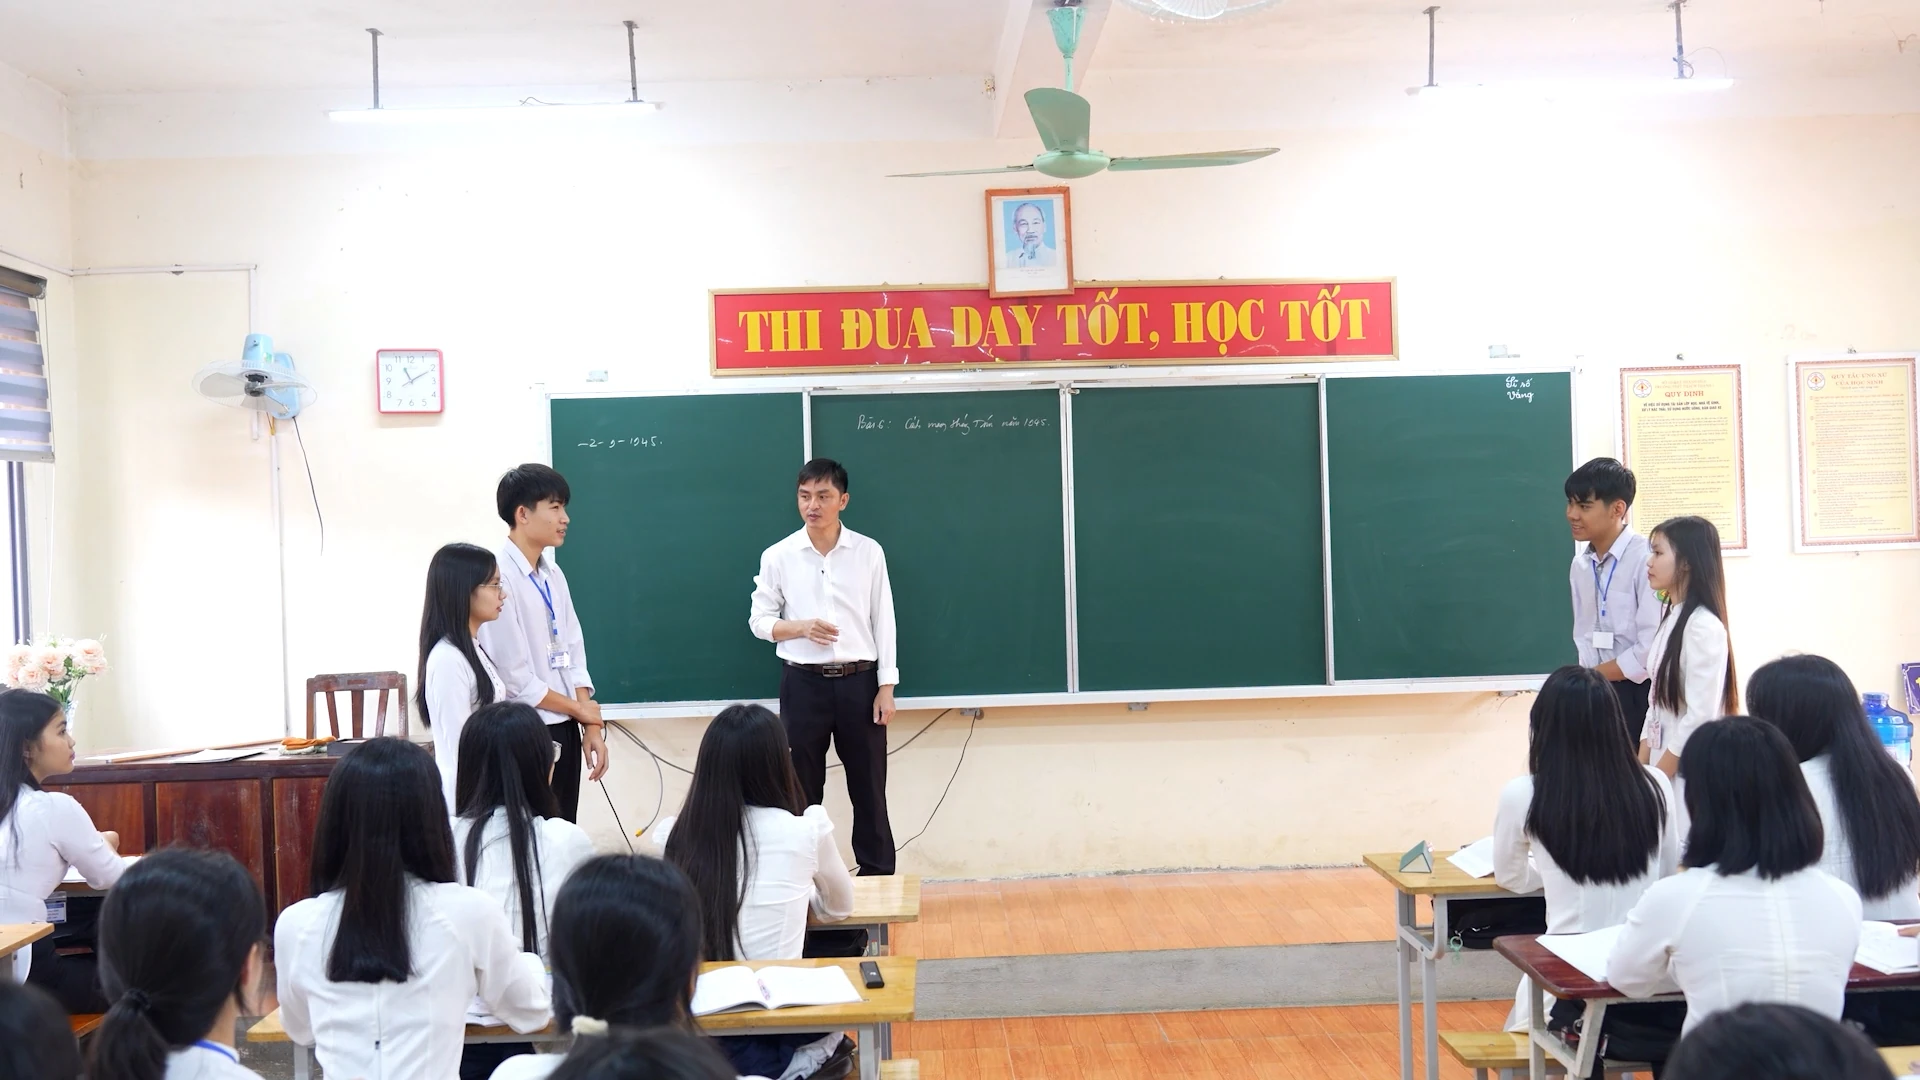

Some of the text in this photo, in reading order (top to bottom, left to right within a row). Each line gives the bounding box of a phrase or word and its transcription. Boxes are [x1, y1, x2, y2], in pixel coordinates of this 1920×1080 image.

[738, 309, 824, 352] THI
[840, 307, 936, 350] ĐUA
[1057, 287, 1160, 350] TỐT,
[1171, 298, 1265, 355] HỌC
[1279, 285, 1370, 342] TỐT
[394, 355, 402, 363] 11
[406, 355, 415, 364] 12
[385, 363, 393, 372] 10
[430, 363, 436, 372] 2
[386, 377, 392, 385] 9
[431, 376, 437, 385] 3
[386, 390, 392, 399] 8
[396, 398, 403, 407] 7
[408, 398, 415, 407] 6
[421, 398, 428, 407] 5
